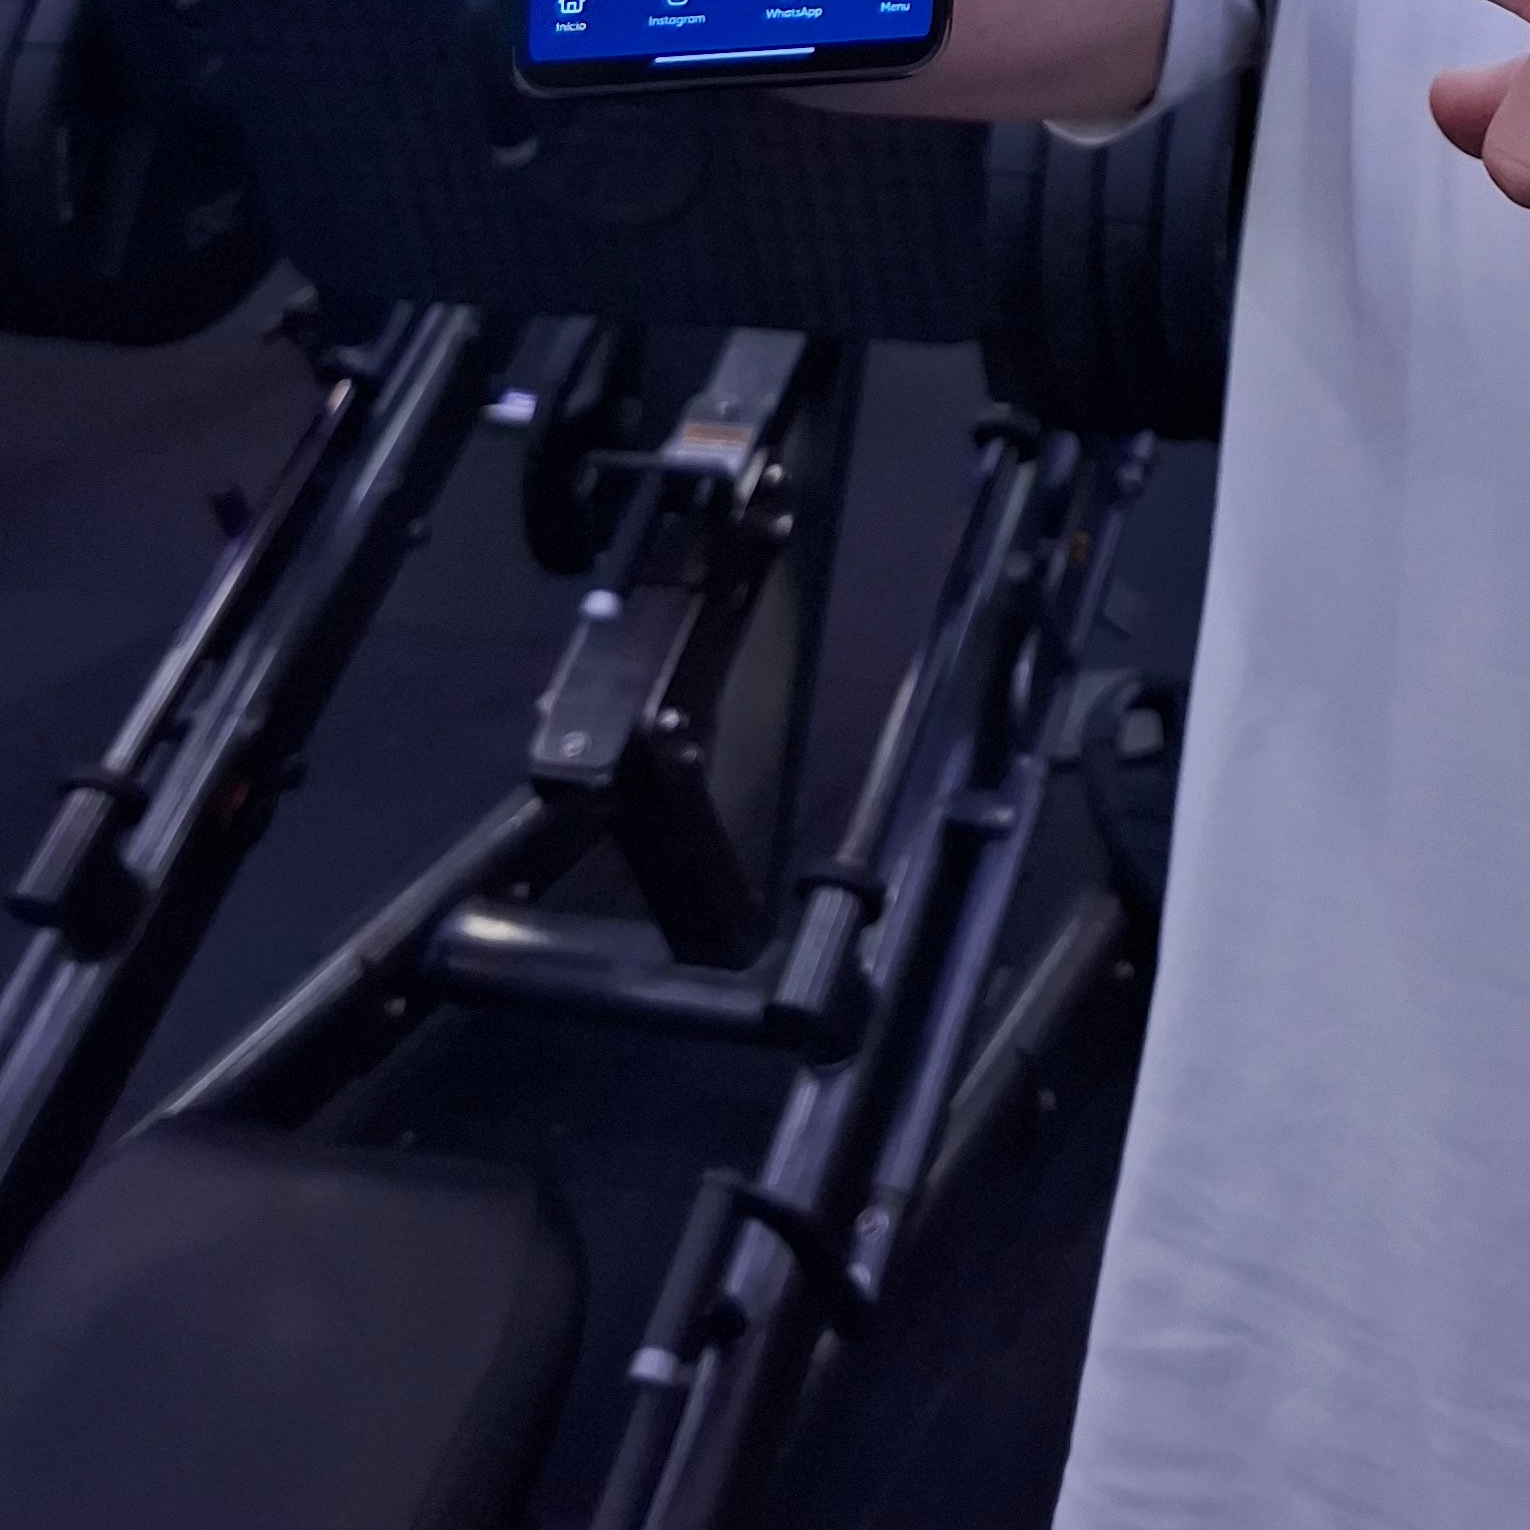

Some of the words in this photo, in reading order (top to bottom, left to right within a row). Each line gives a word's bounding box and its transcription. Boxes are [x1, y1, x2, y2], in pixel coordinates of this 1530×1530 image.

[765, 6, 823, 20] WhatsApp
[880, 1, 911, 13] Menu
[555, 22, 587, 32] Início
[648, 14, 706, 28] Instagram
